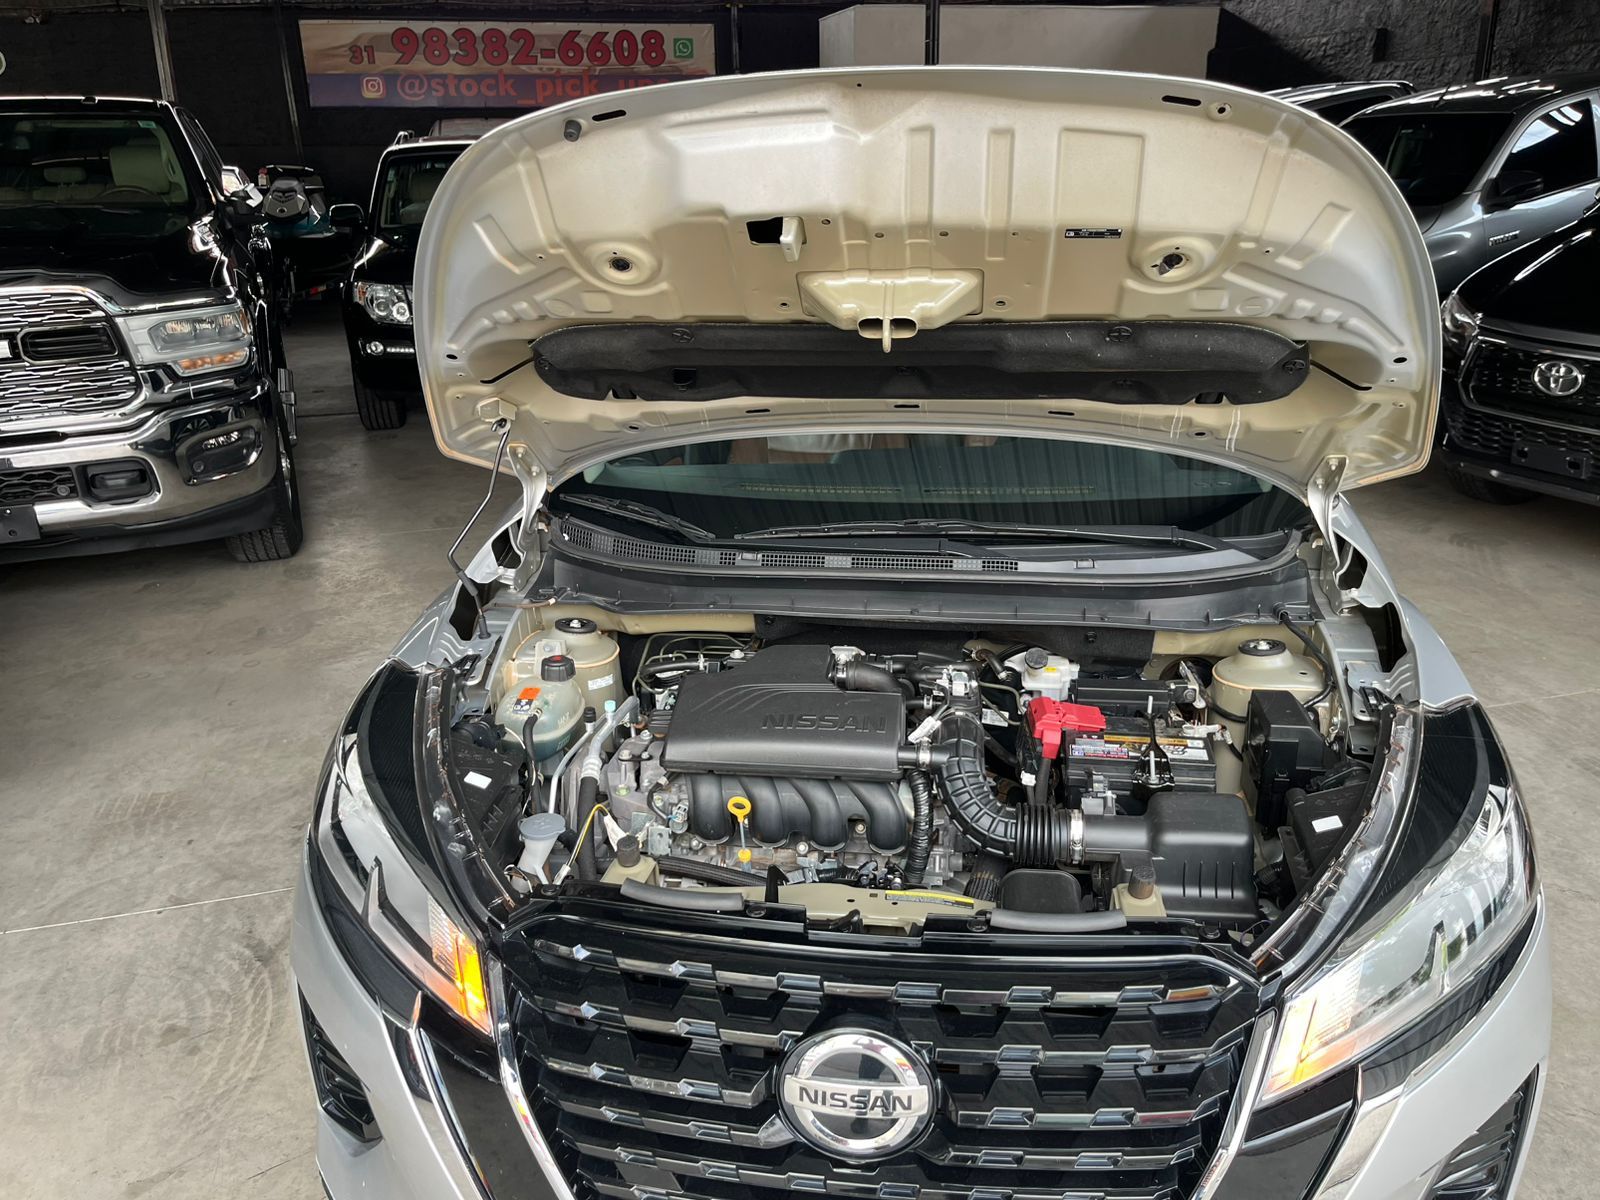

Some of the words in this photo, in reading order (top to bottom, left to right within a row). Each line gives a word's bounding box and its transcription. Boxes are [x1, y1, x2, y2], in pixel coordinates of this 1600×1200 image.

[348, 44, 377, 65] 31
[391, 27, 667, 67] 98382-6608
[761, 711, 888, 734] NISSAN
[799, 1086, 913, 1112] NISSAN
